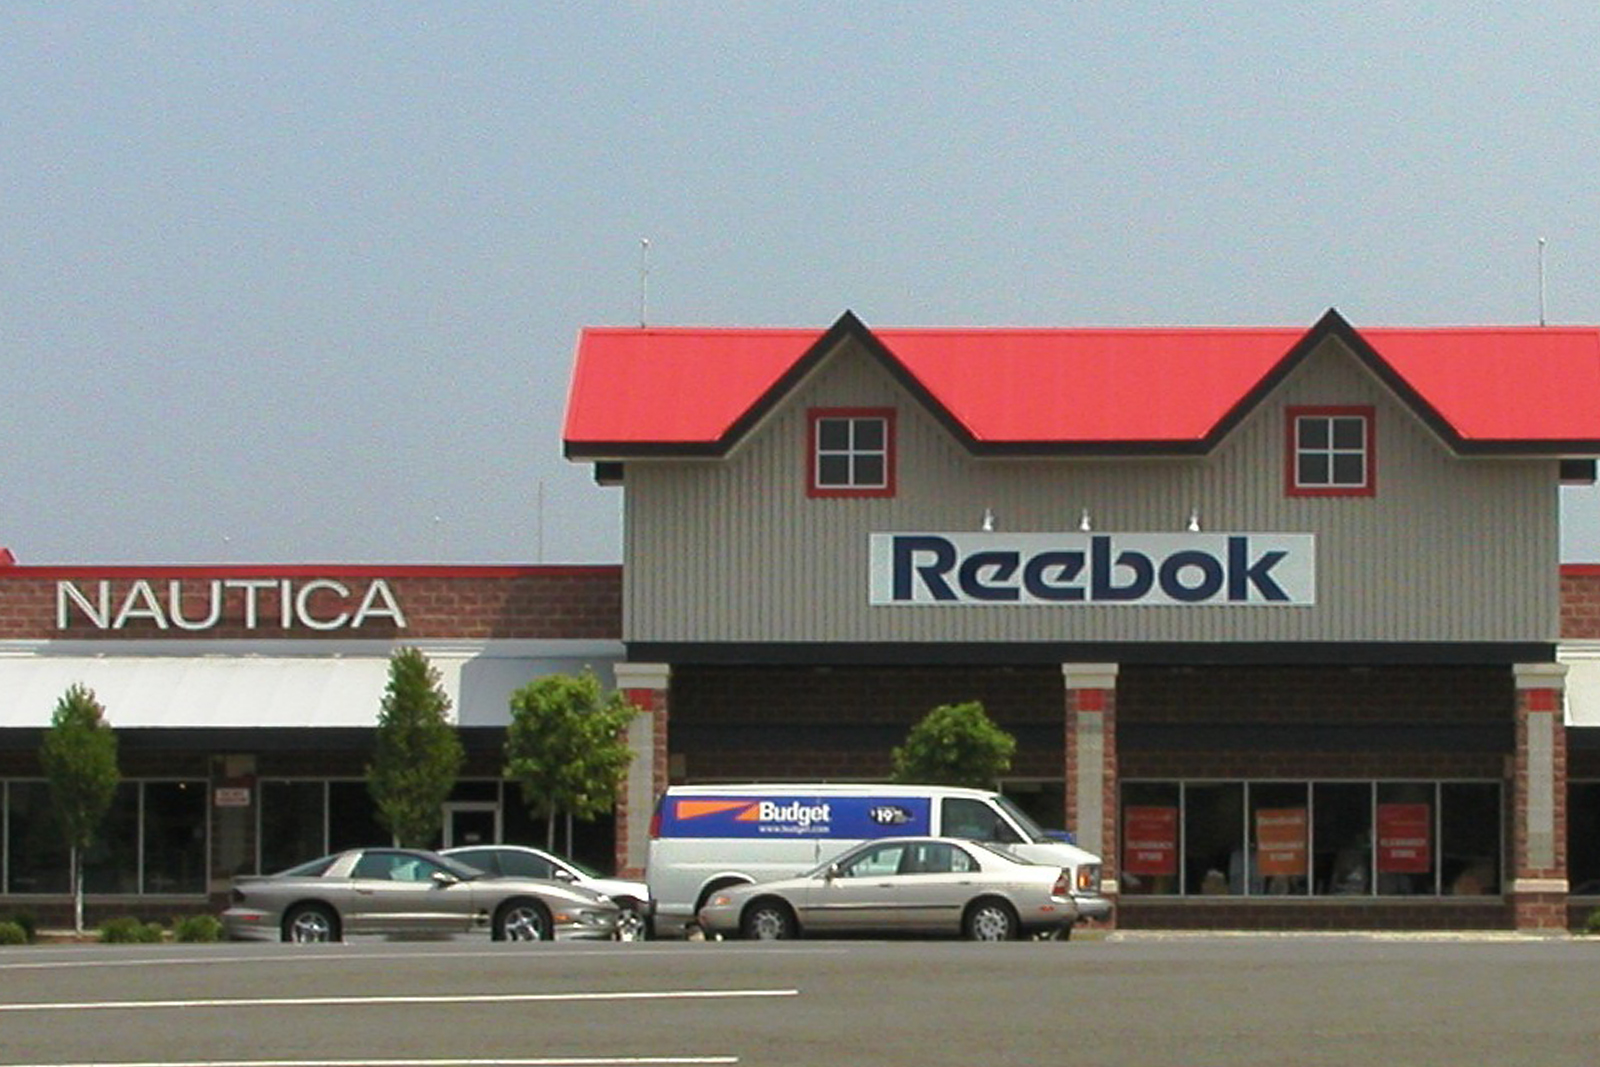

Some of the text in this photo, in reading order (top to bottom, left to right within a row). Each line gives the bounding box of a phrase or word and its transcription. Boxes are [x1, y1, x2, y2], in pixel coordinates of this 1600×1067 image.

[892, 535, 1291, 602] Reebok
[56, 579, 407, 630] NAUTICA
[759, 801, 830, 826] Budget
